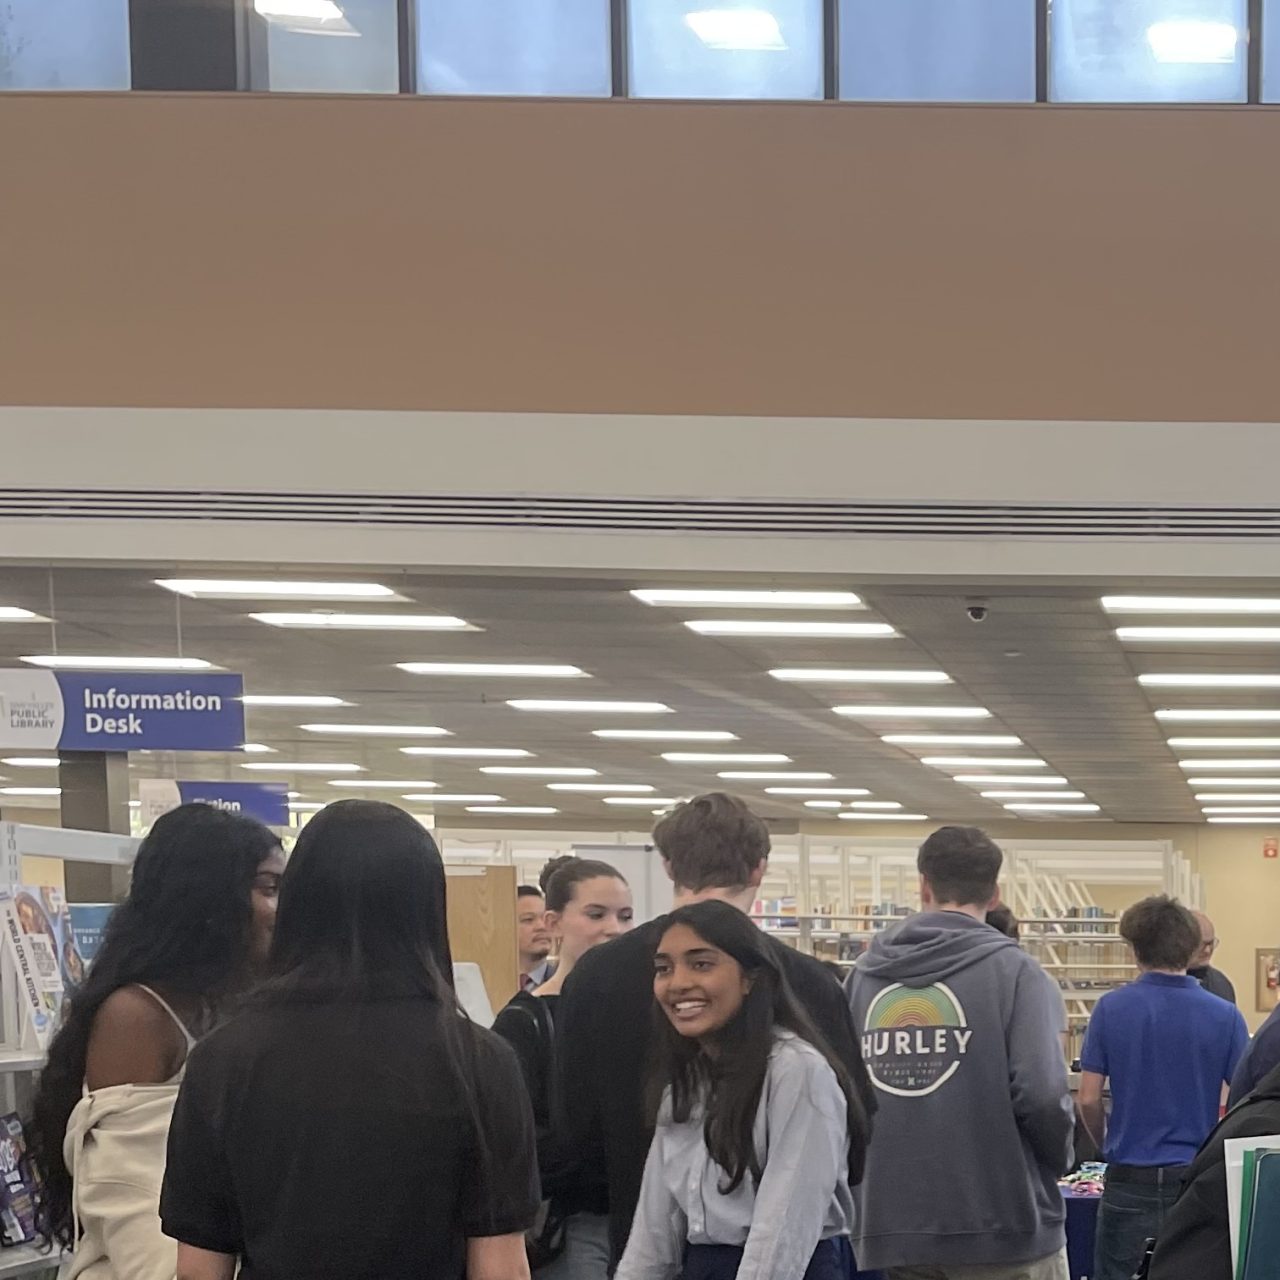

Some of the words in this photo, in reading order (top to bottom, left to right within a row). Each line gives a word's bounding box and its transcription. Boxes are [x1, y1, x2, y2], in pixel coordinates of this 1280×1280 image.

[84, 688, 222, 711] Information
[10, 709, 49, 718] PUBLIC
[10, 719, 56, 729] LIBRARY
[85, 713, 143, 734] Desk
[8, 919, 20, 943] WORLD
[16, 944, 30, 977] CENTRAL
[26, 978, 40, 1007] KITCHEN
[861, 1029, 973, 1059] HURLEY
